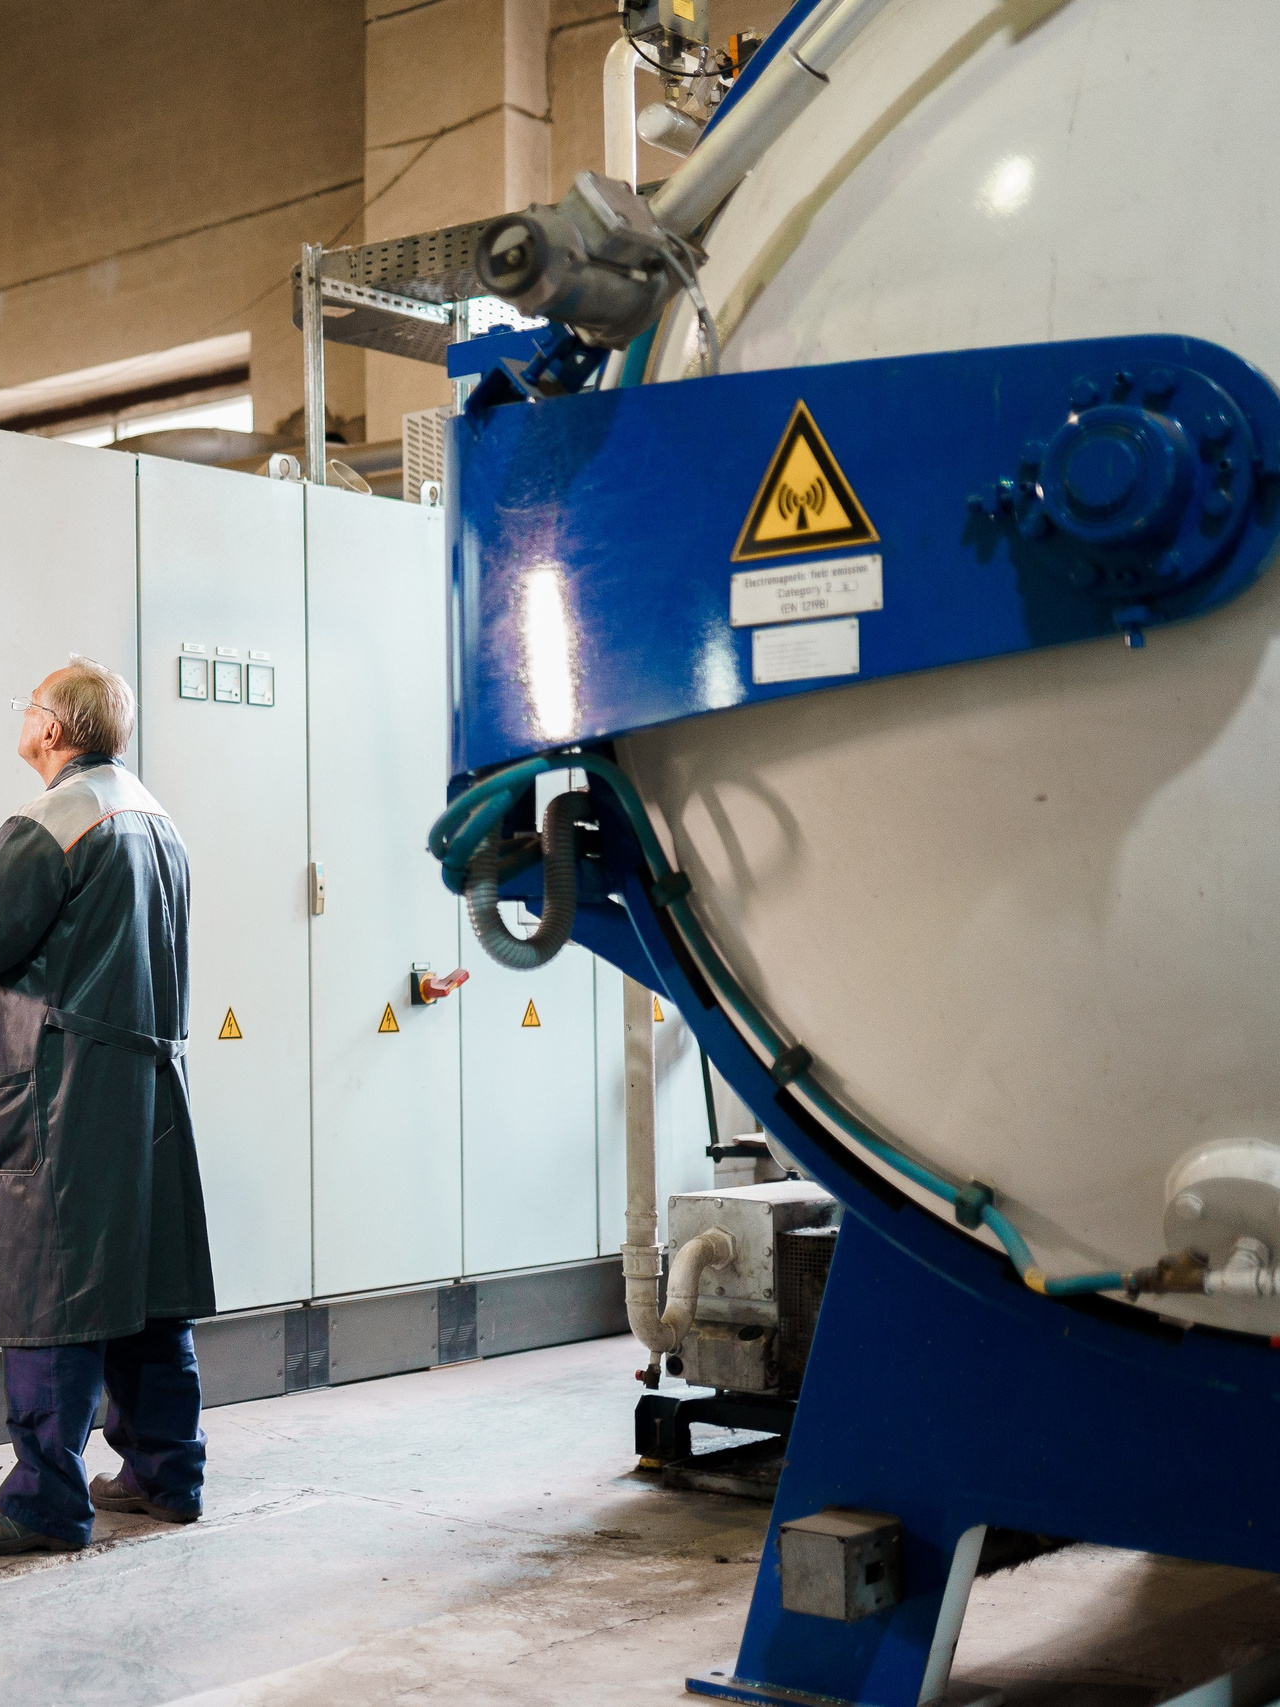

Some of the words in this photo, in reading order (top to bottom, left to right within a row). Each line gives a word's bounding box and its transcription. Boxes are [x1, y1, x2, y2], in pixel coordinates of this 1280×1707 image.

[744, 571, 806, 588] Electromagnetic
[810, 568, 829, 579] field
[832, 564, 869, 576] emission
[778, 584, 821, 599] Category
